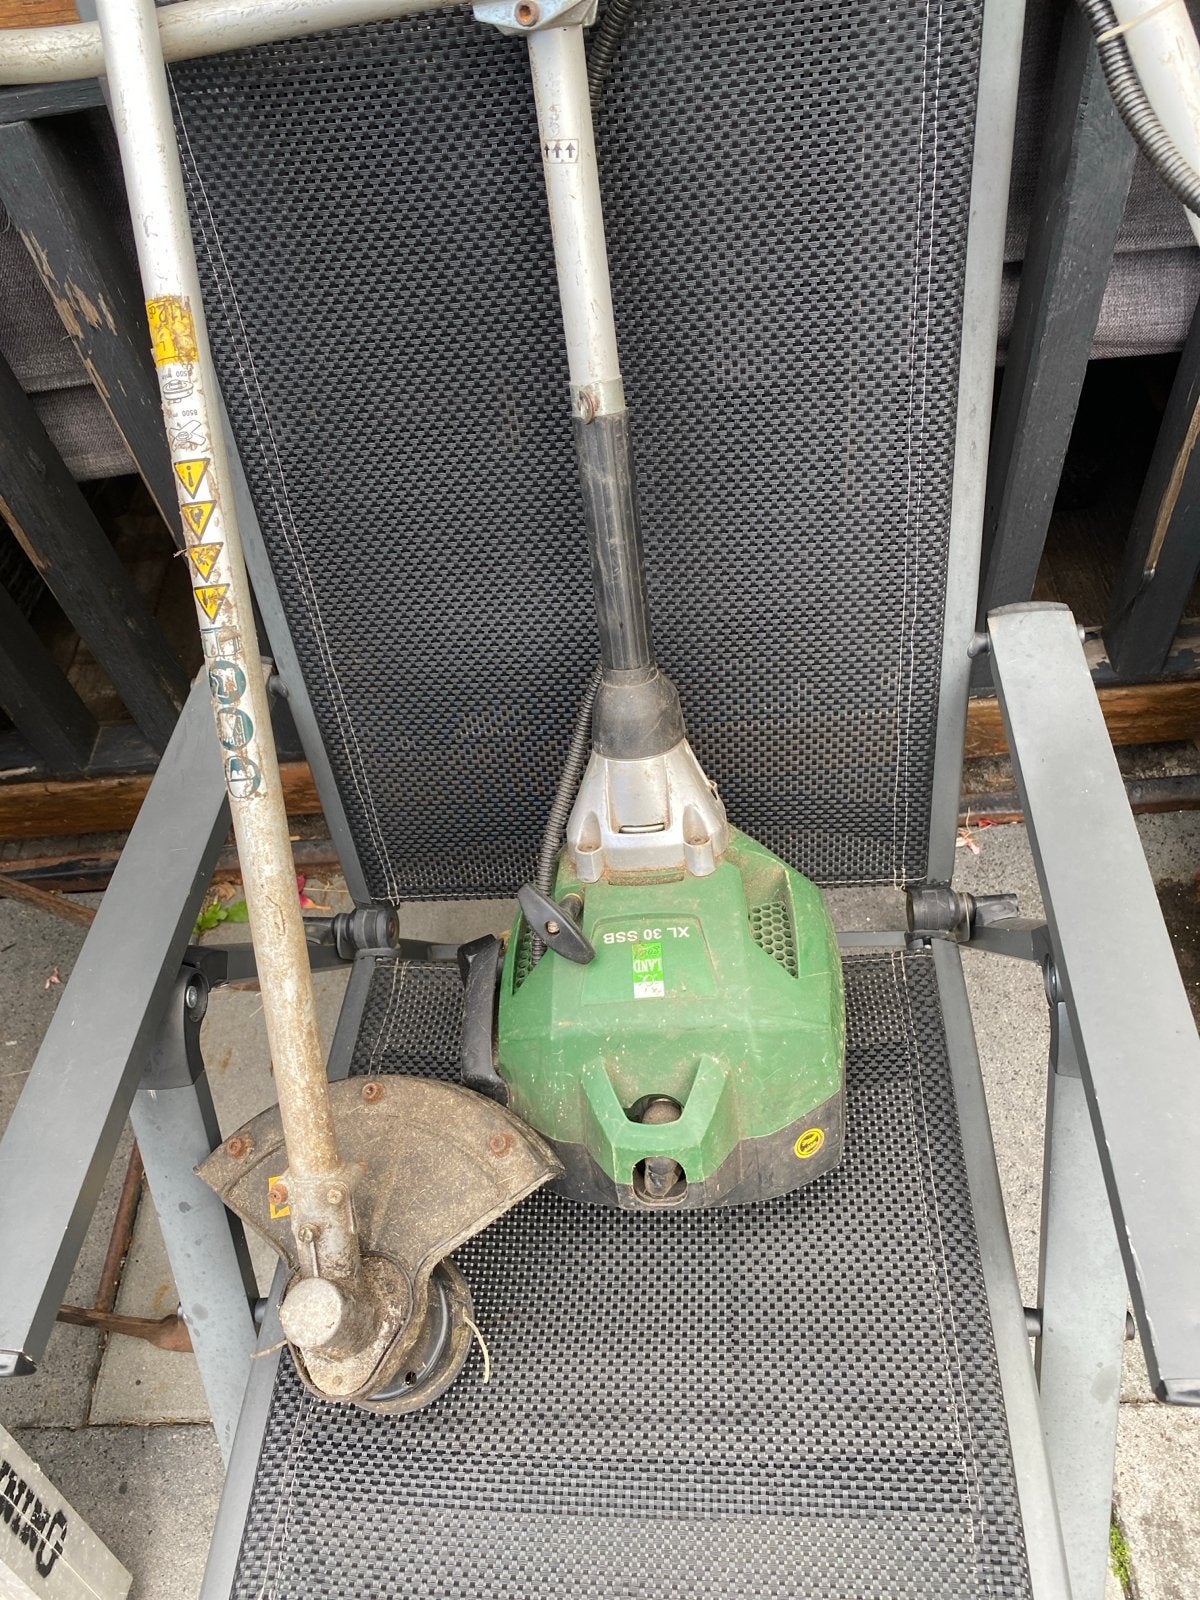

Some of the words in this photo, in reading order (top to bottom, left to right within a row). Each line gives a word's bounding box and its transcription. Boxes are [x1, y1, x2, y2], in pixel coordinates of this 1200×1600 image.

[181, 409, 198, 417] 8500
[603, 930, 638, 944] SSB
[643, 928, 662, 941] 30
[666, 927, 690, 938] XL
[634, 958, 662, 973] LAND
